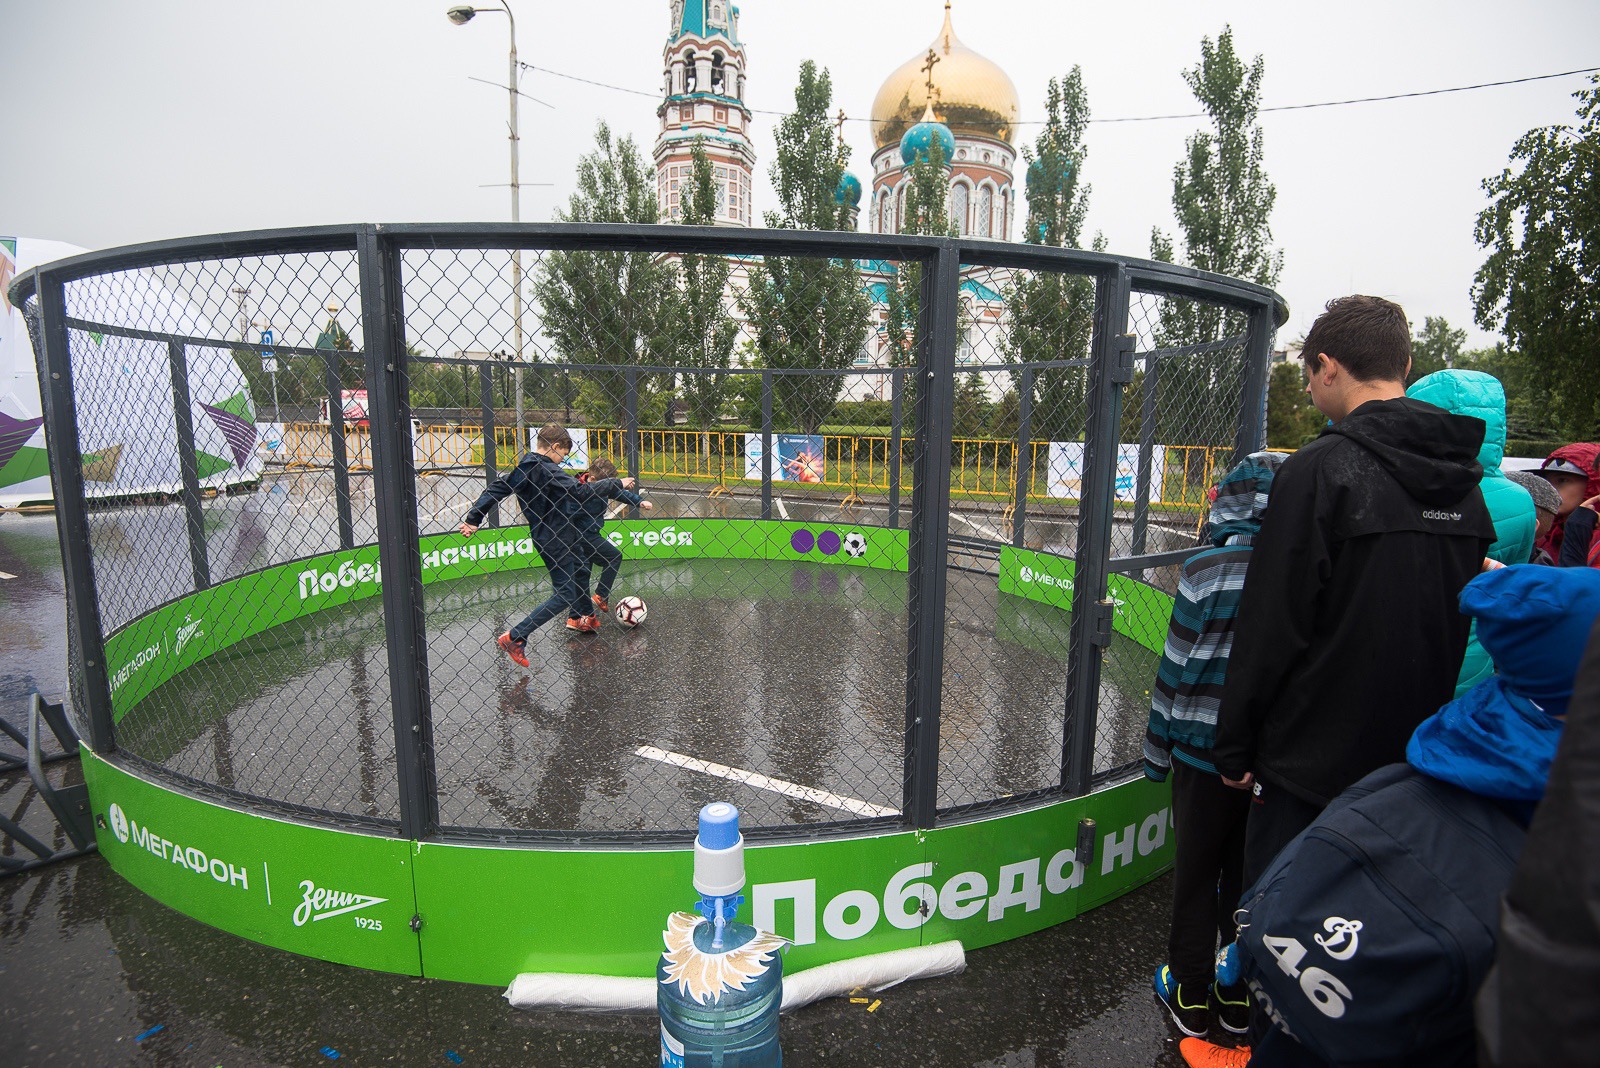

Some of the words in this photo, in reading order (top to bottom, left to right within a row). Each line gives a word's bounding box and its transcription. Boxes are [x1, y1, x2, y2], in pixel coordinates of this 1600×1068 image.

[1422, 510, 1450, 521] adidas
[422, 537, 534, 569] начина
[607, 532, 623, 548] с
[629, 526, 693, 548] тебя
[1035, 571, 1075, 591] МЕГАФ
[131, 820, 248, 890] МЕГАФОН
[752, 846, 1085, 946] Победа
[1101, 805, 1175, 875] на
[354, 916, 383, 932] 1925
[1262, 933, 1353, 1019] 46
